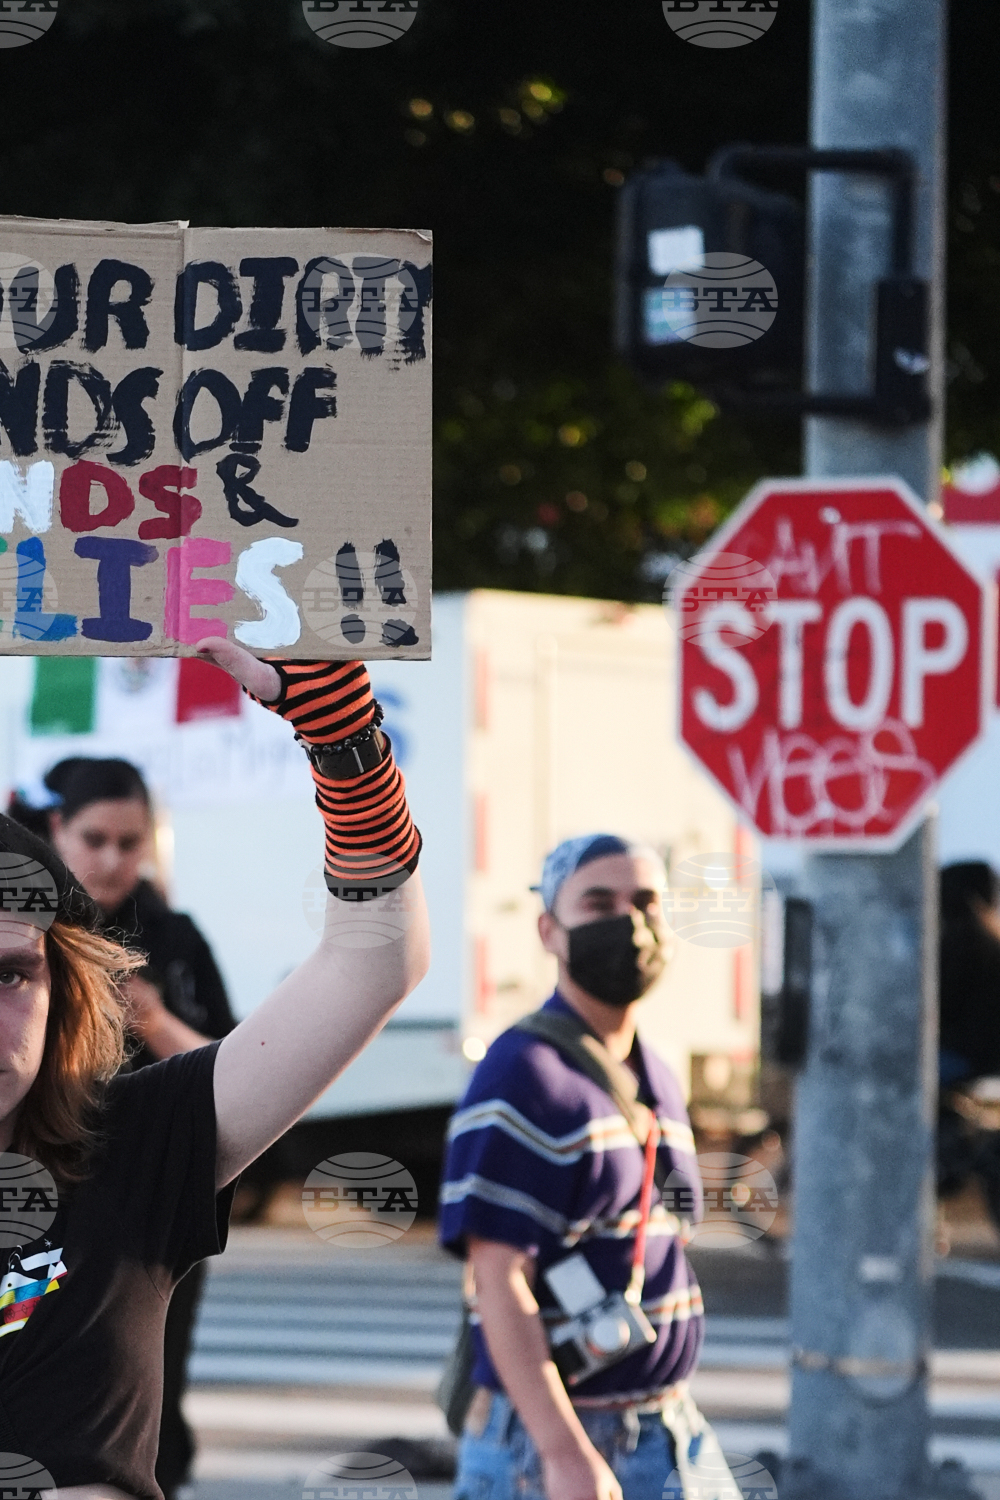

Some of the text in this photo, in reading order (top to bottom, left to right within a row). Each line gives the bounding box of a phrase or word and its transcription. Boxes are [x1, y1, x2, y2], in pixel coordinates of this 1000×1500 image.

[173, 255, 433, 371] DIRTY
[174, 365, 338, 463] OFF
[215, 453, 300, 528] &
[334, 538, 420, 648] !!
[692, 595, 970, 733] STOP
